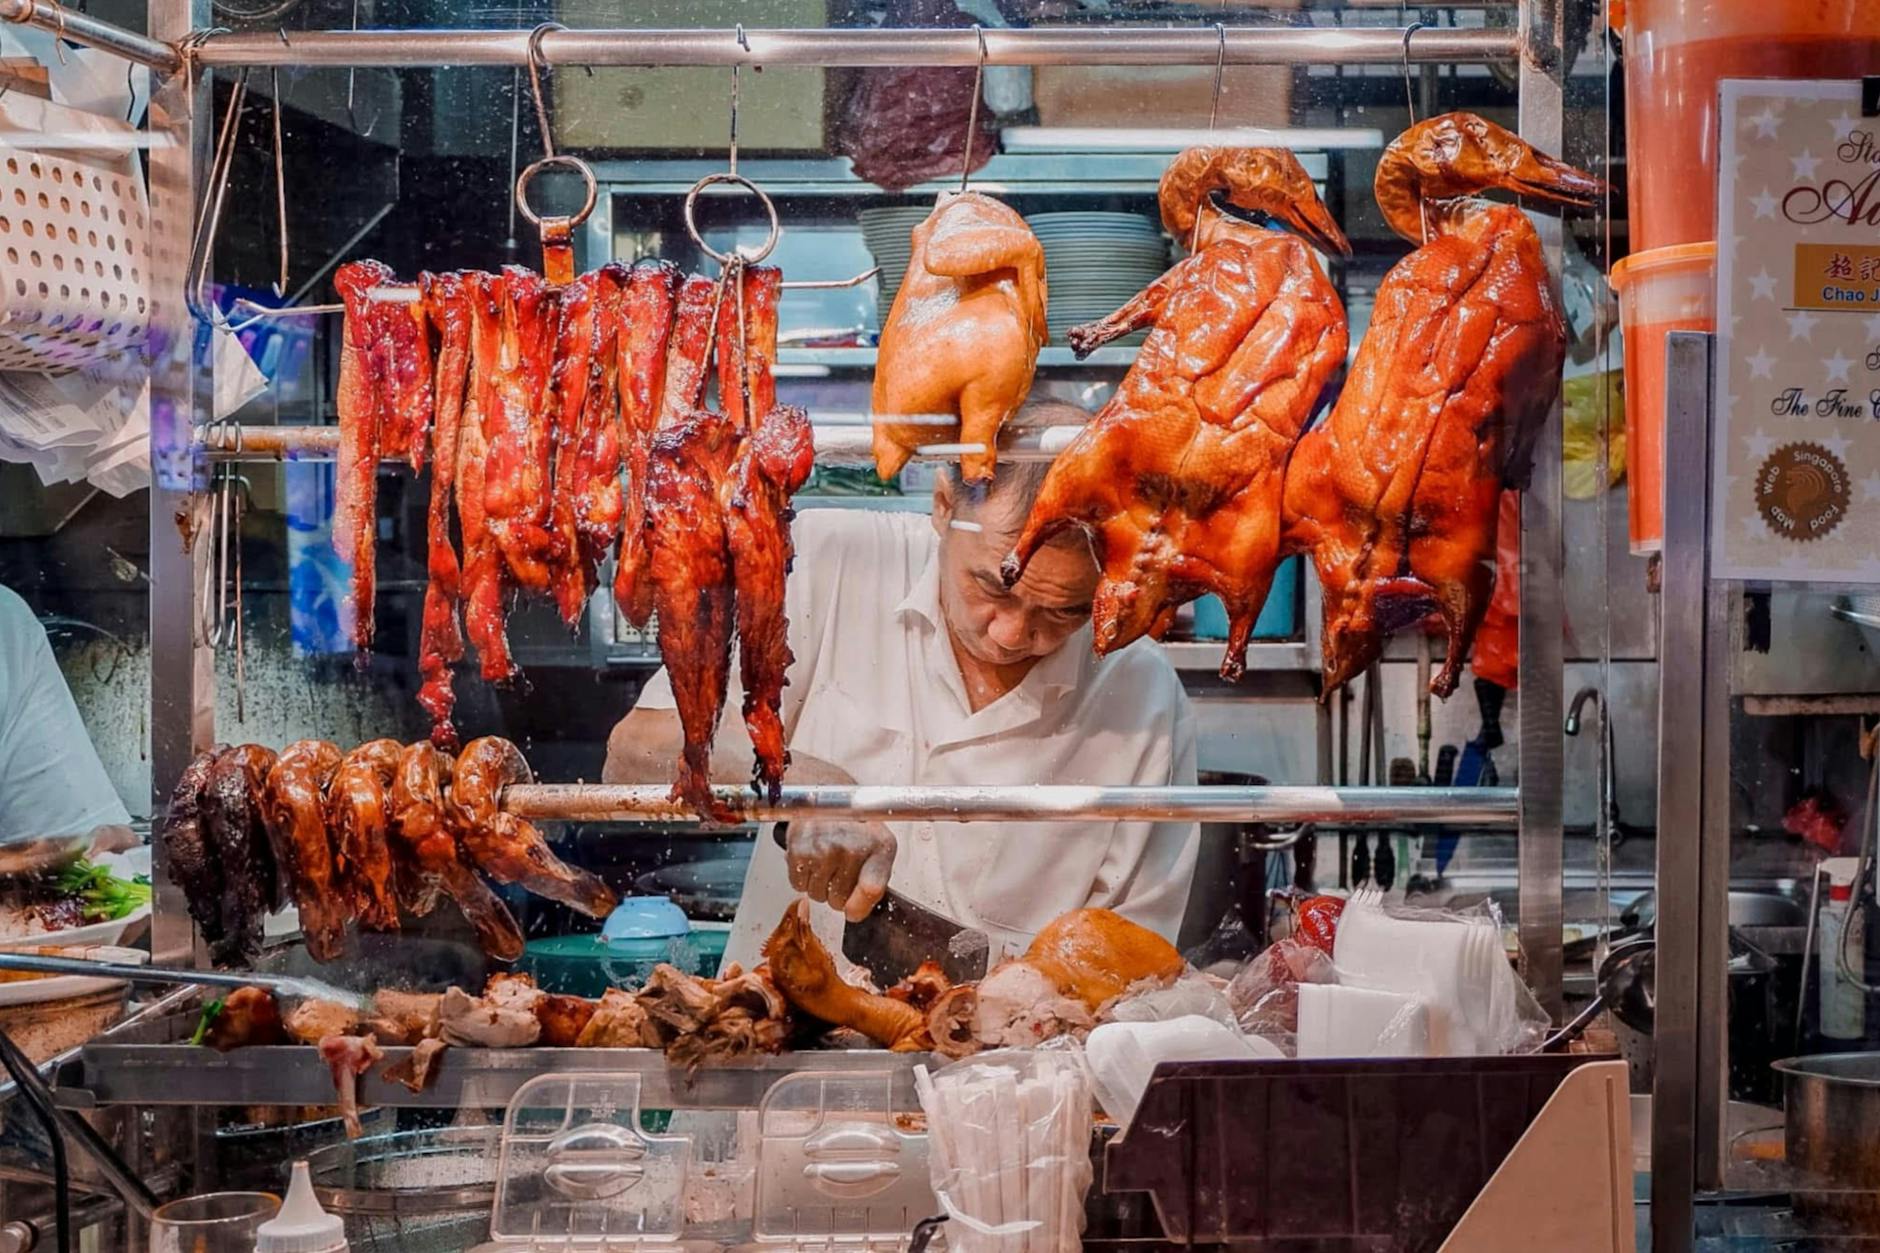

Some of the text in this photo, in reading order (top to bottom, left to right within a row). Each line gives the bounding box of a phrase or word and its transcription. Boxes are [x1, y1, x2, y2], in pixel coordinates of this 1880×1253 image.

[1823, 286, 1865, 301] Chao
[1771, 387, 1809, 417] The
[1815, 388, 1863, 418] Fine
[1763, 450, 1842, 532] Singapore Food Map Web
